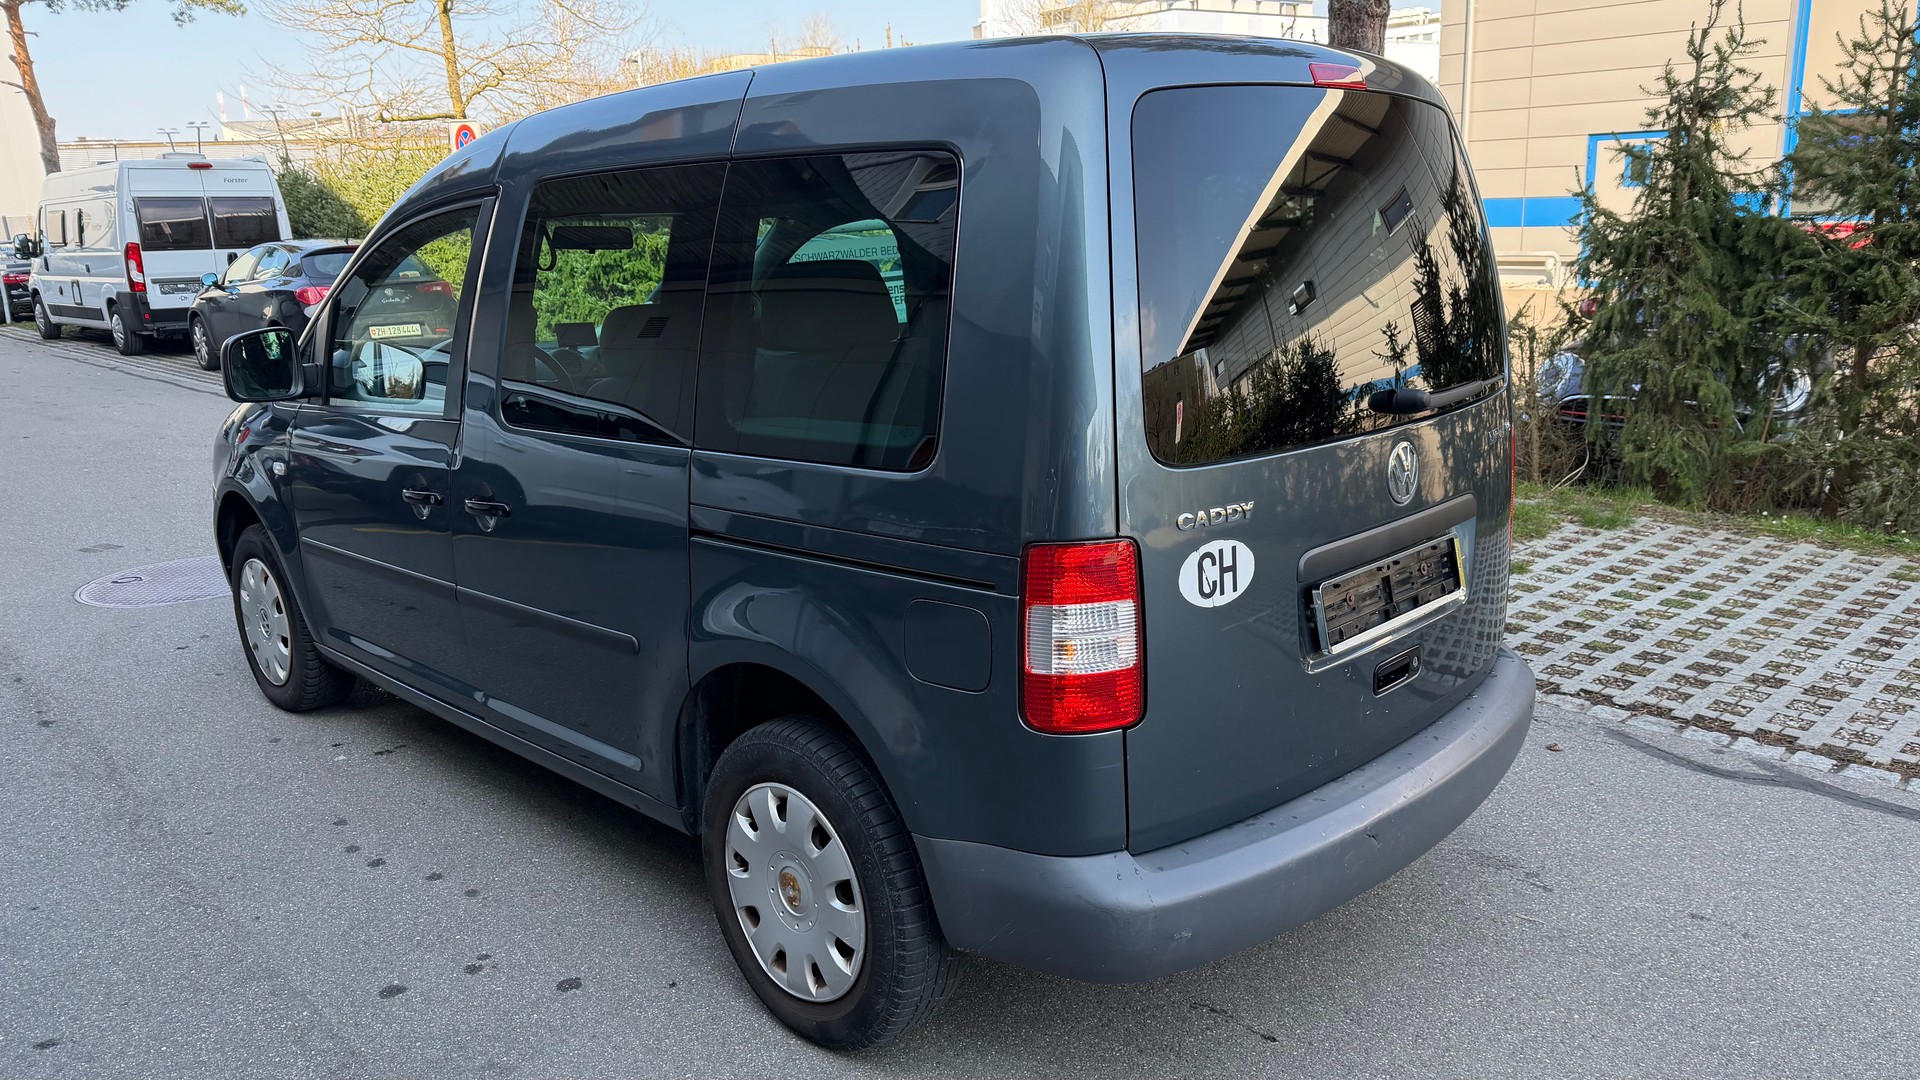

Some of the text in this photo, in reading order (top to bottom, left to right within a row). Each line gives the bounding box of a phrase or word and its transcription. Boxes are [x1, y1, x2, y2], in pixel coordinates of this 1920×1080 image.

[794, 247, 878, 261] SCHWARZWÄLDER
[1177, 501, 1254, 531] CADDY
[1197, 545, 1238, 600] CH
